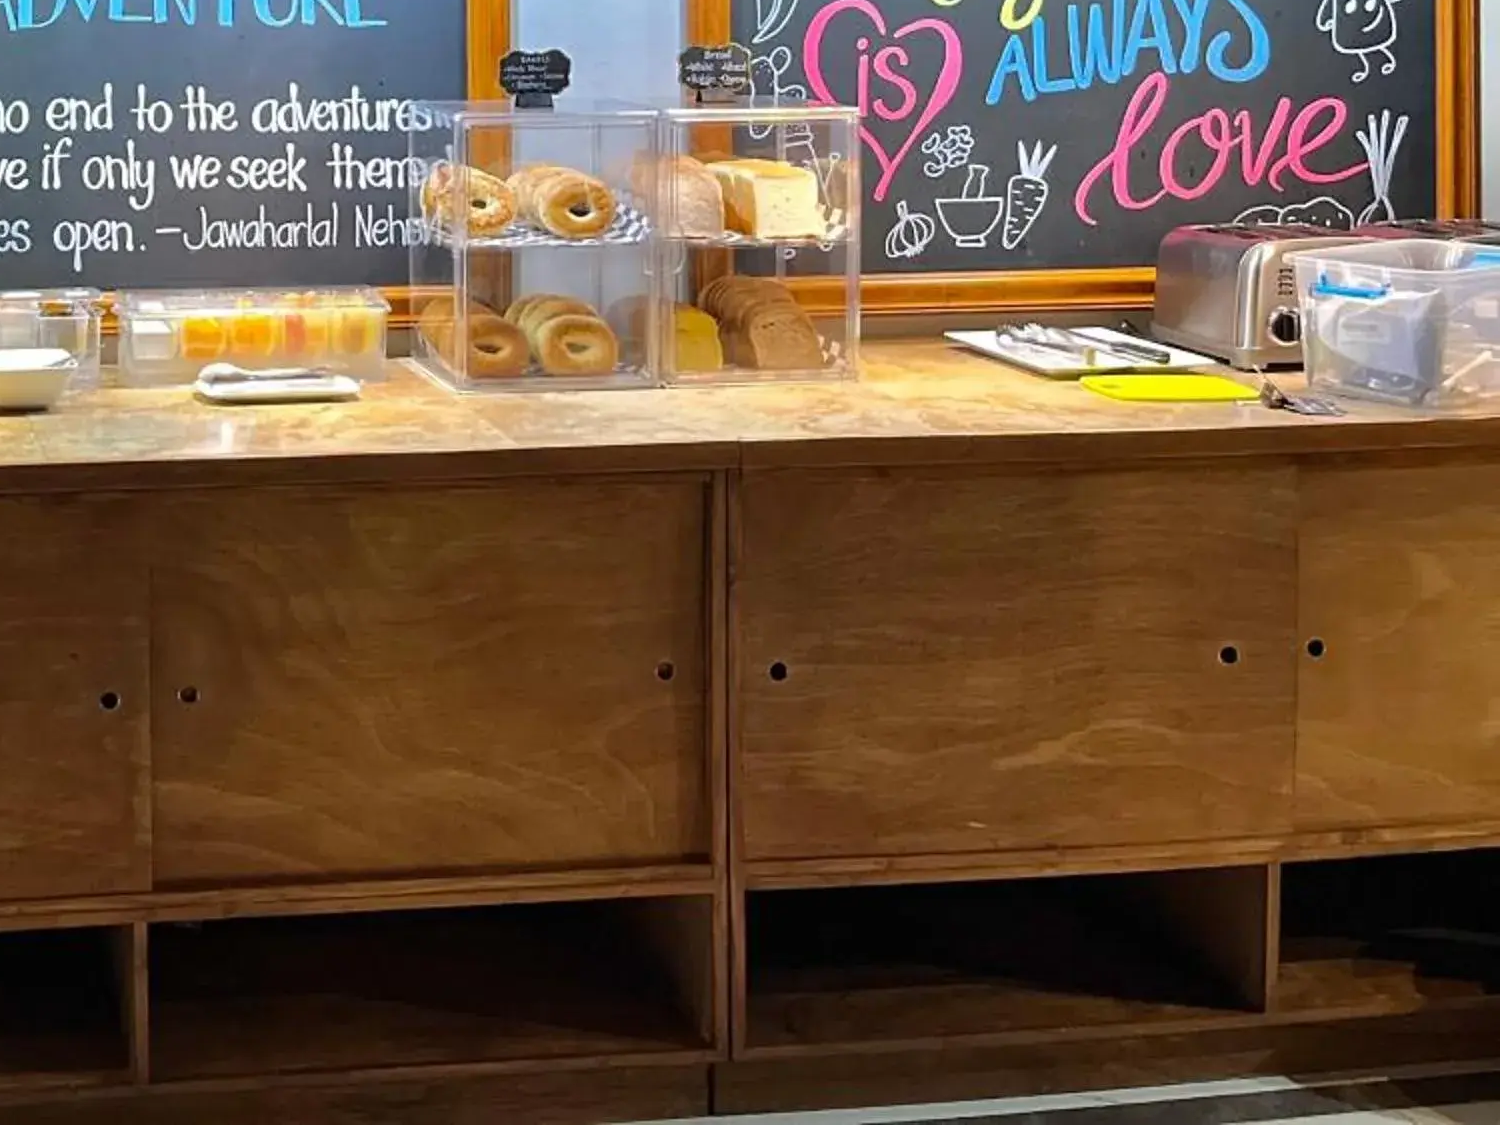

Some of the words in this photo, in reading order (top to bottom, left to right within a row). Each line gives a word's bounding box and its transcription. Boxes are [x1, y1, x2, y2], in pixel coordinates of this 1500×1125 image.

[44, 82, 114, 133] end
[131, 82, 174, 133] to
[180, 83, 239, 133] the
[251, 82, 433, 134] adventures
[854, 34, 918, 121] is
[40, 136, 74, 191] if
[81, 137, 156, 211] only
[169, 153, 221, 192] we
[227, 141, 308, 192] seek
[52, 217, 148, 272] open.
